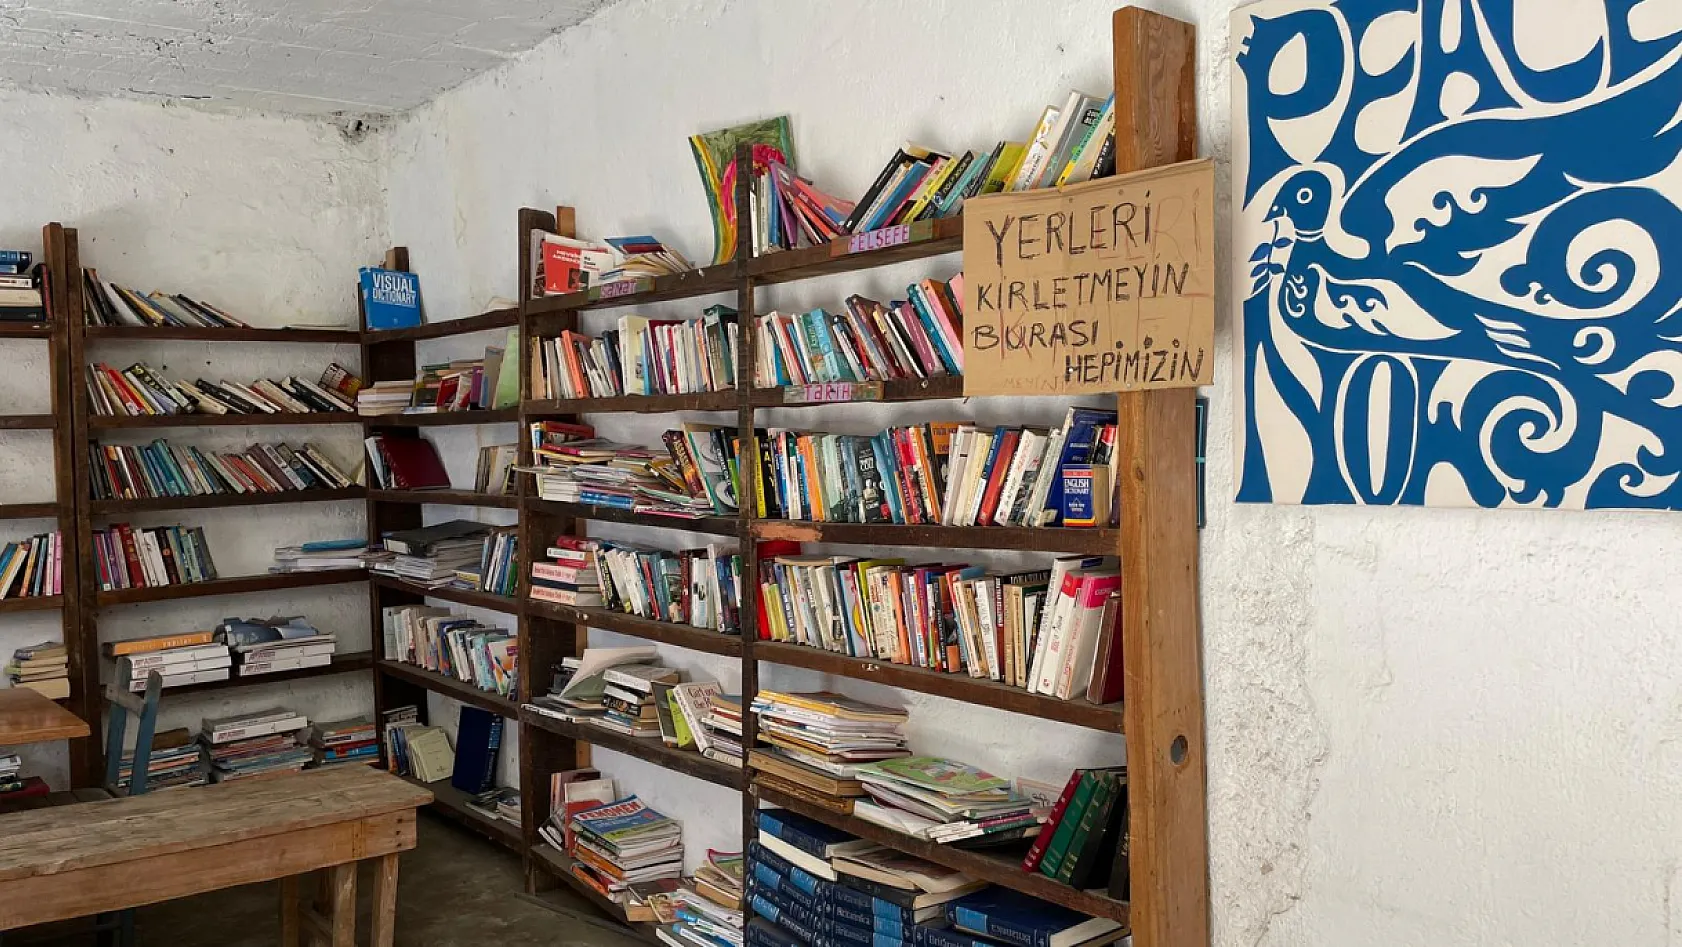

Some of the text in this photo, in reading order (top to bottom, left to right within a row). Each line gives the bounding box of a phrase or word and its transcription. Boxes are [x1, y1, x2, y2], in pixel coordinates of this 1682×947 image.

[850, 225, 909, 251] FELSEFE
[985, 190, 1151, 267] YERLERİ
[372, 272, 416, 294] VISUAL
[372, 287, 417, 305] DICTIONARY
[971, 319, 1099, 350] BURASI
[1064, 478, 1089, 488] ENGLISH
[578, 800, 643, 821] FENOMEN
